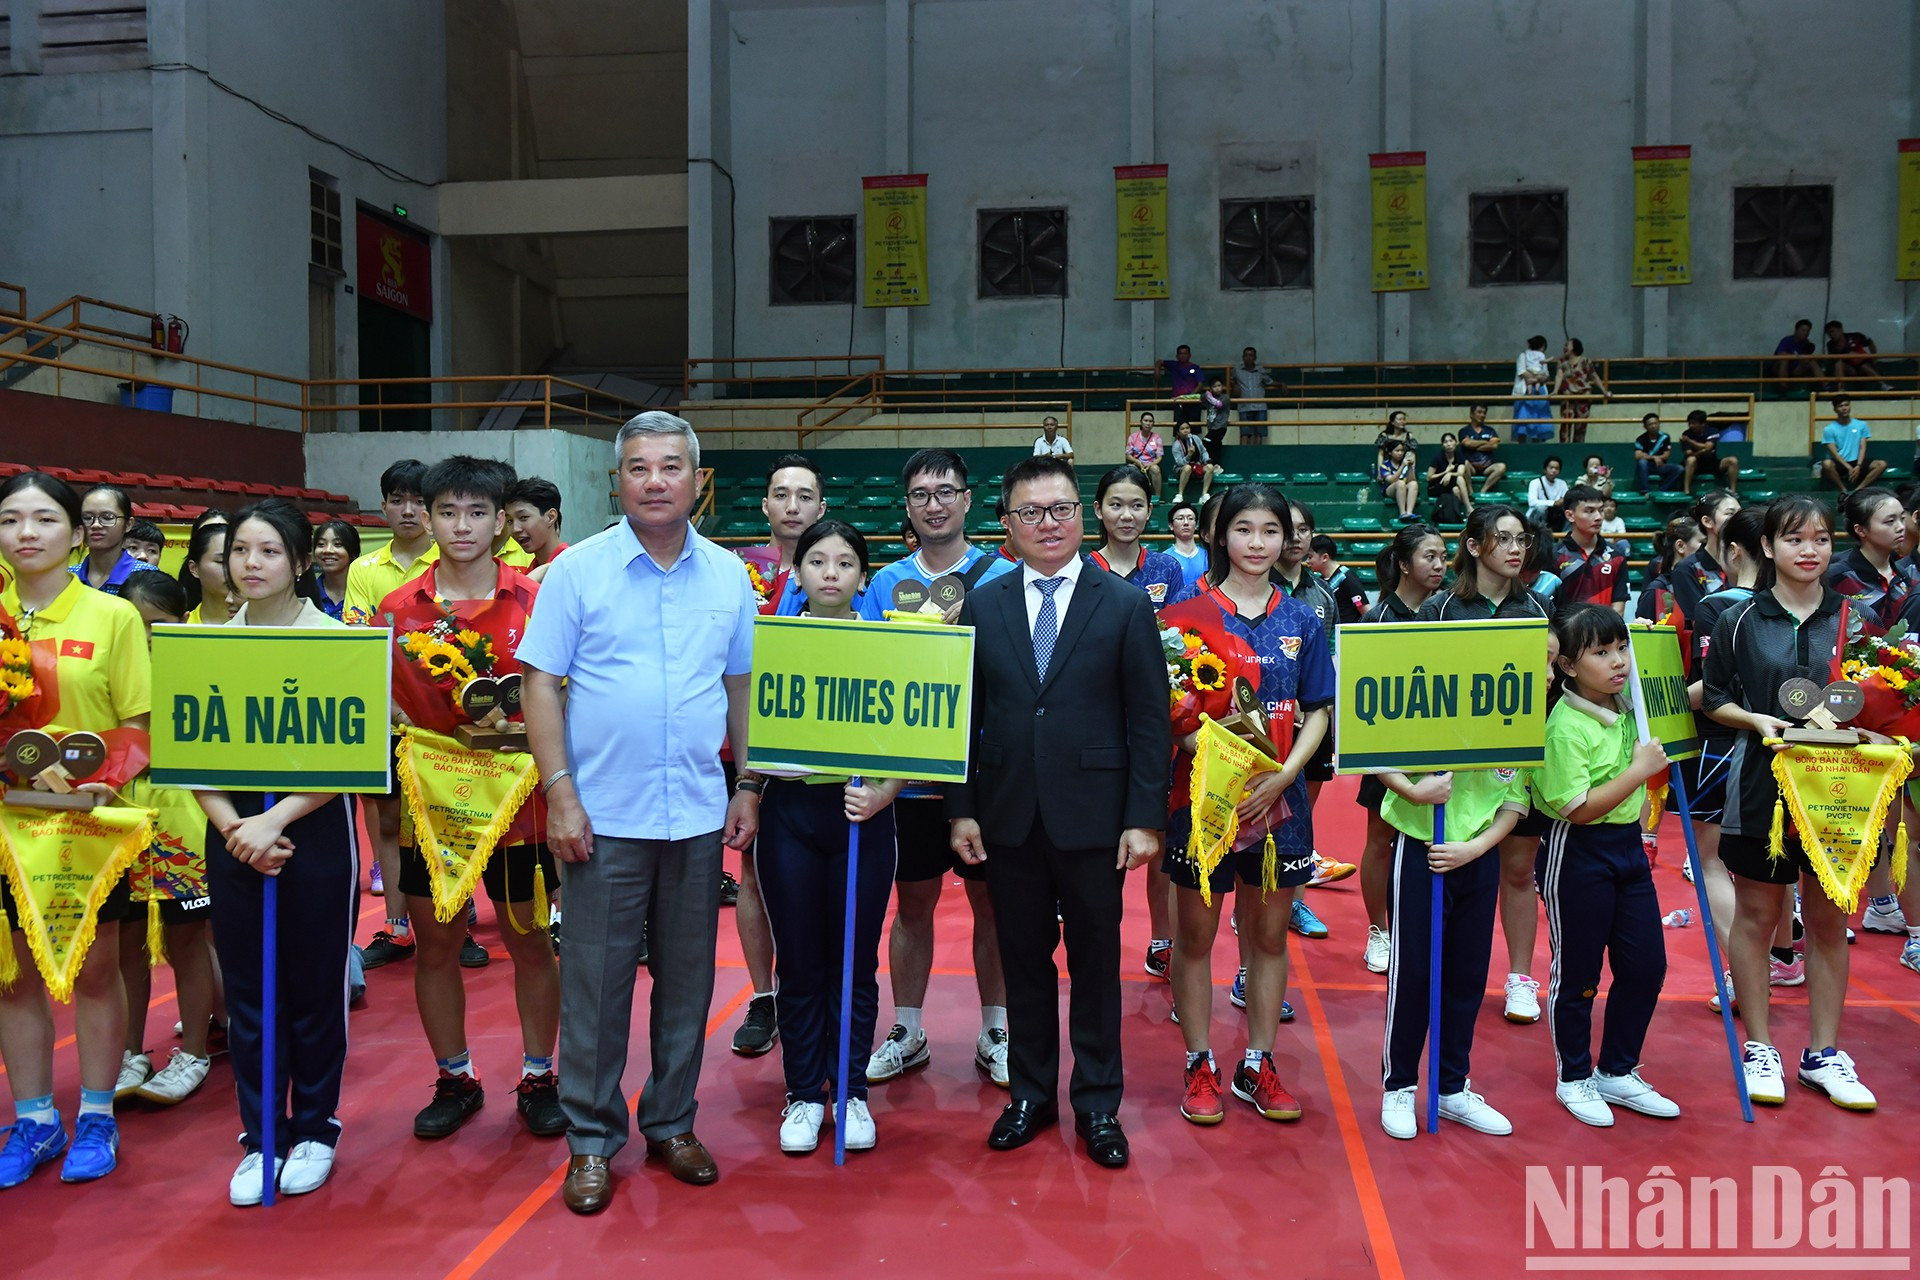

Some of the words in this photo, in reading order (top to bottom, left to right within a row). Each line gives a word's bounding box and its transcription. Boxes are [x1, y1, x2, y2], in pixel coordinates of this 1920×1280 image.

[376, 282, 409, 307] SAIGON
[757, 671, 806, 719] CLB
[815, 675, 895, 726] TIMES
[903, 681, 962, 729] CITY
[1355, 665, 1459, 726] QUÂN
[1470, 662, 1533, 726] ĐỘI
[172, 684, 231, 743] ĐÀ
[245, 678, 366, 745] NẴNG
[422, 751, 449, 763] BÓNG
[499, 763, 515, 773] GIA
[429, 804, 492, 819] PETROVIETNAM
[1808, 804, 1870, 813] PETROVIETNAM
[1826, 812, 1853, 820] PVCFC
[446, 814, 473, 825] PVCFC
[105, 825, 123, 834] GIA
[32, 874, 94, 882] PETROVIETNAM
